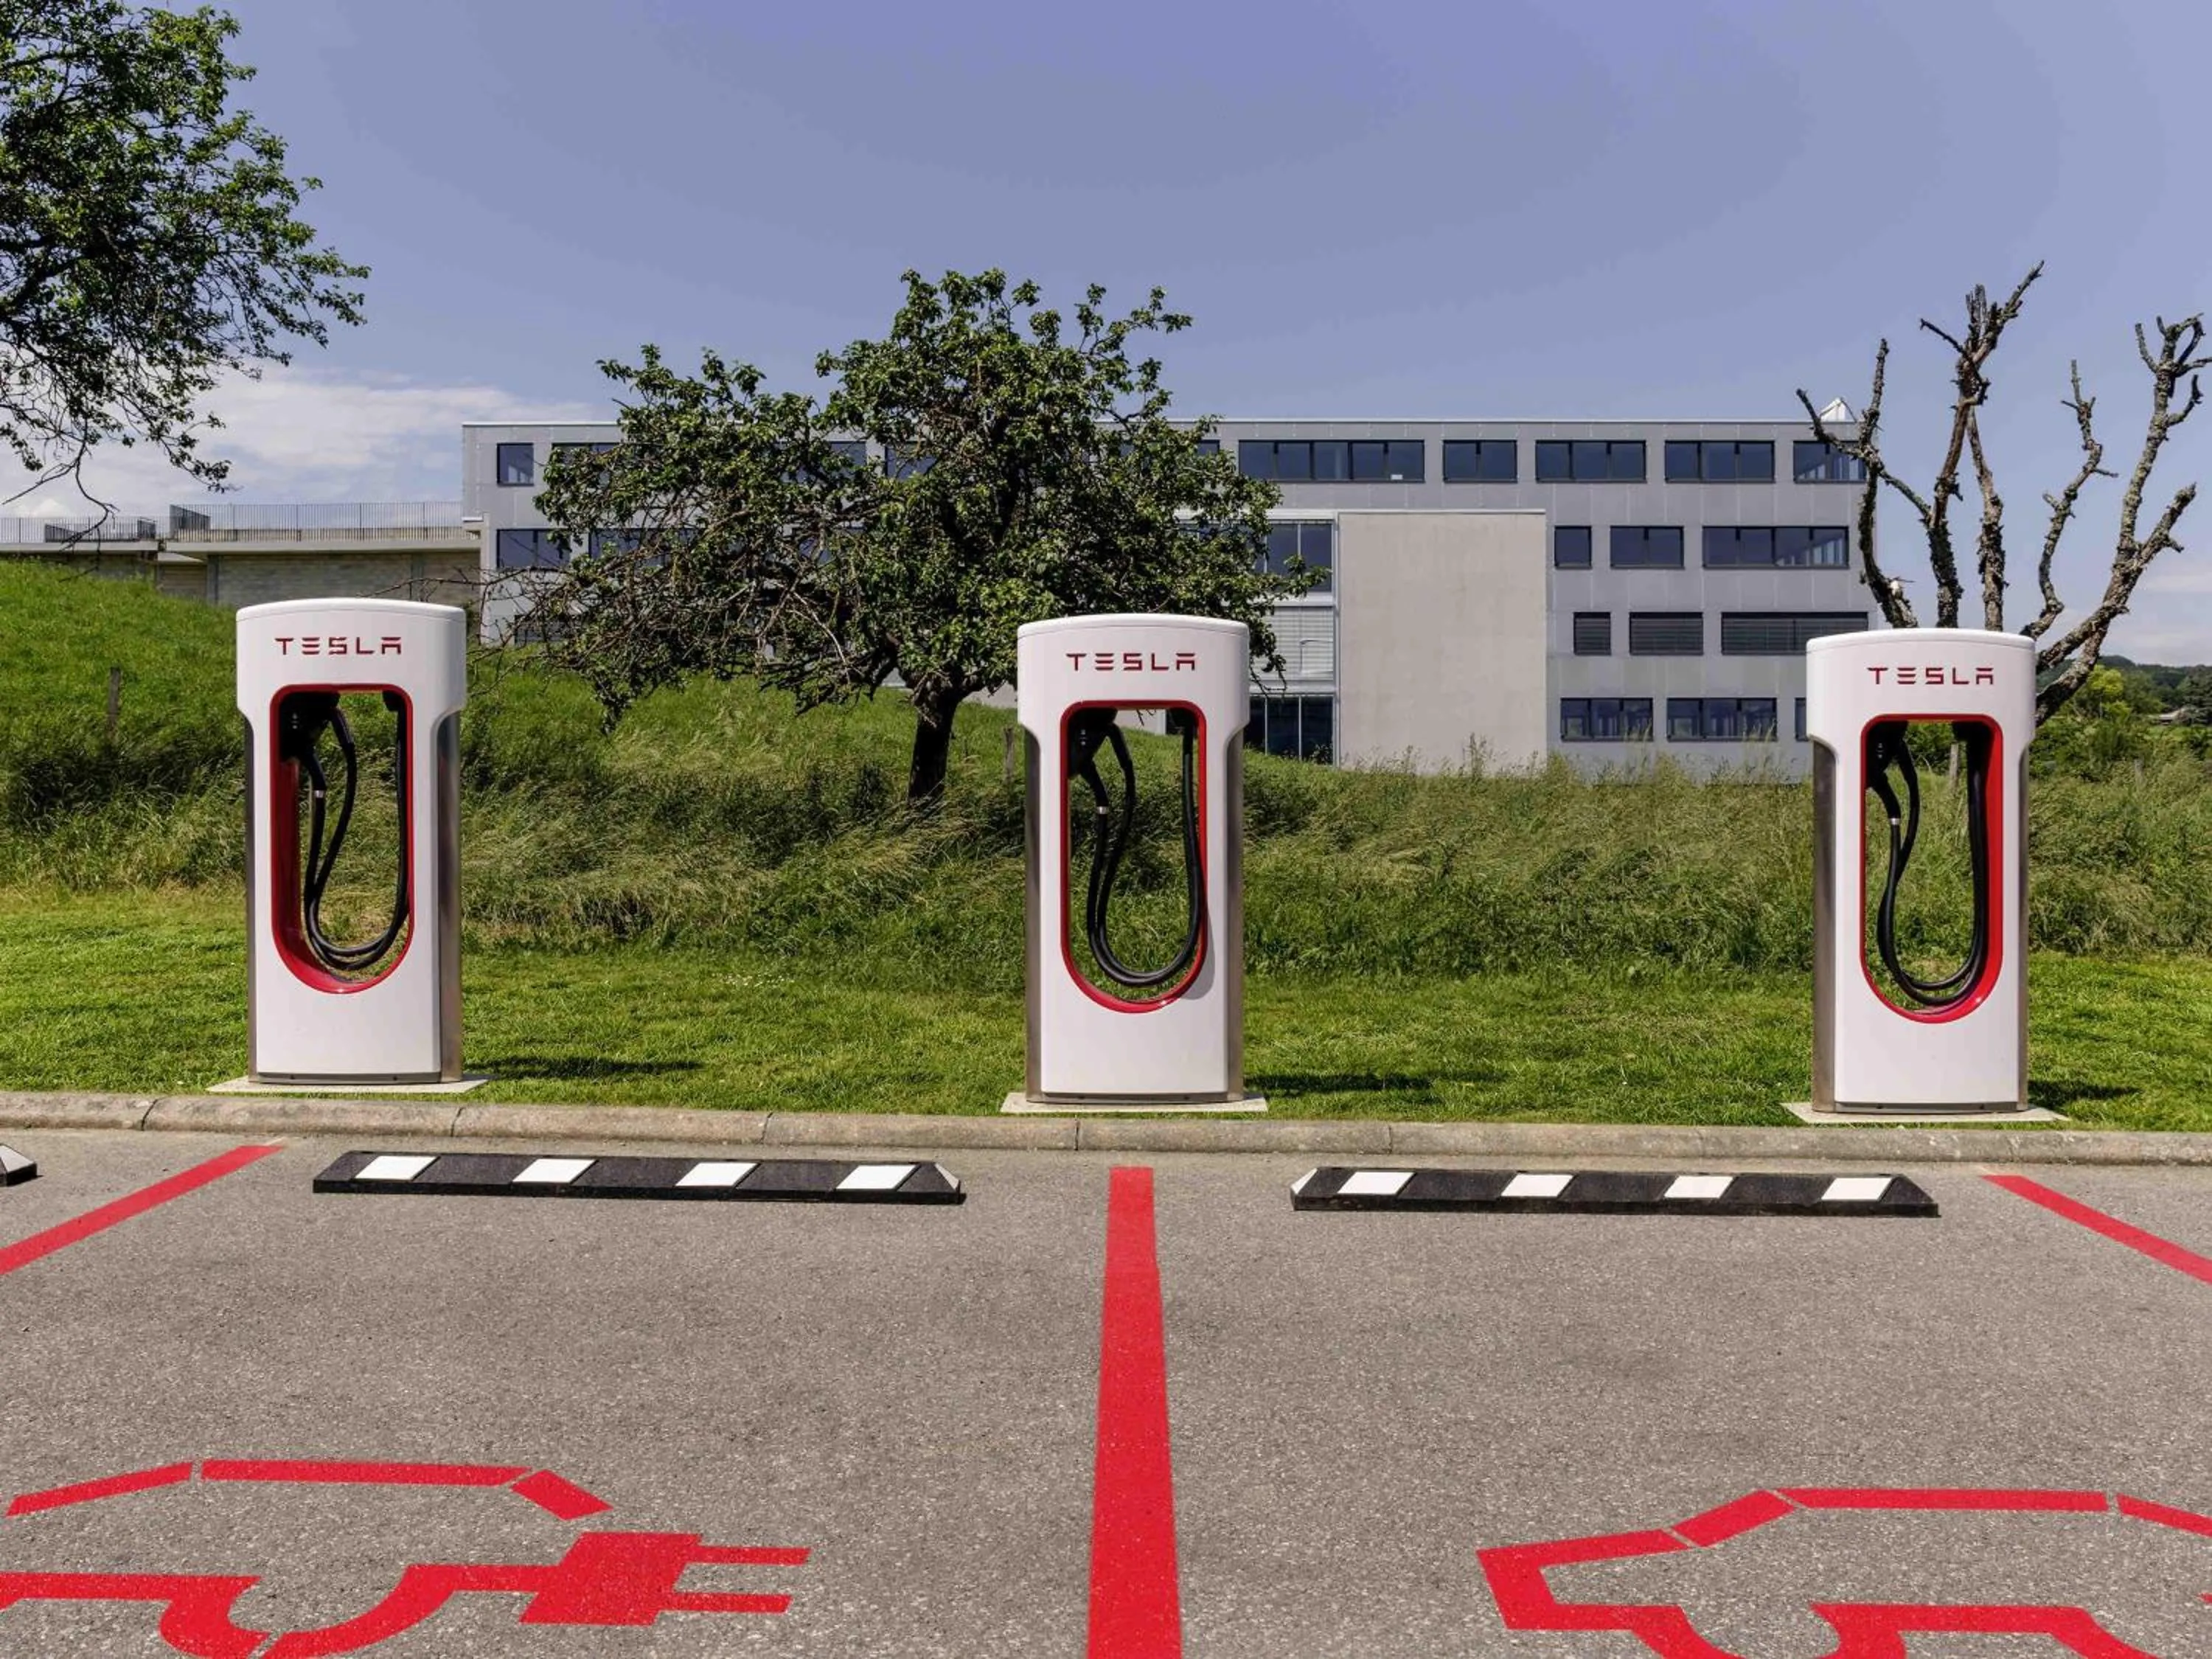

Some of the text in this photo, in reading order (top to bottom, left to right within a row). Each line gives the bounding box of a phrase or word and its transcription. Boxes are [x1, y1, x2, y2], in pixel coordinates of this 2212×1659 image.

[274, 636, 402, 655] TESLA
[1065, 652, 1196, 672] TESLA
[1866, 667, 1994, 686] TESLA
